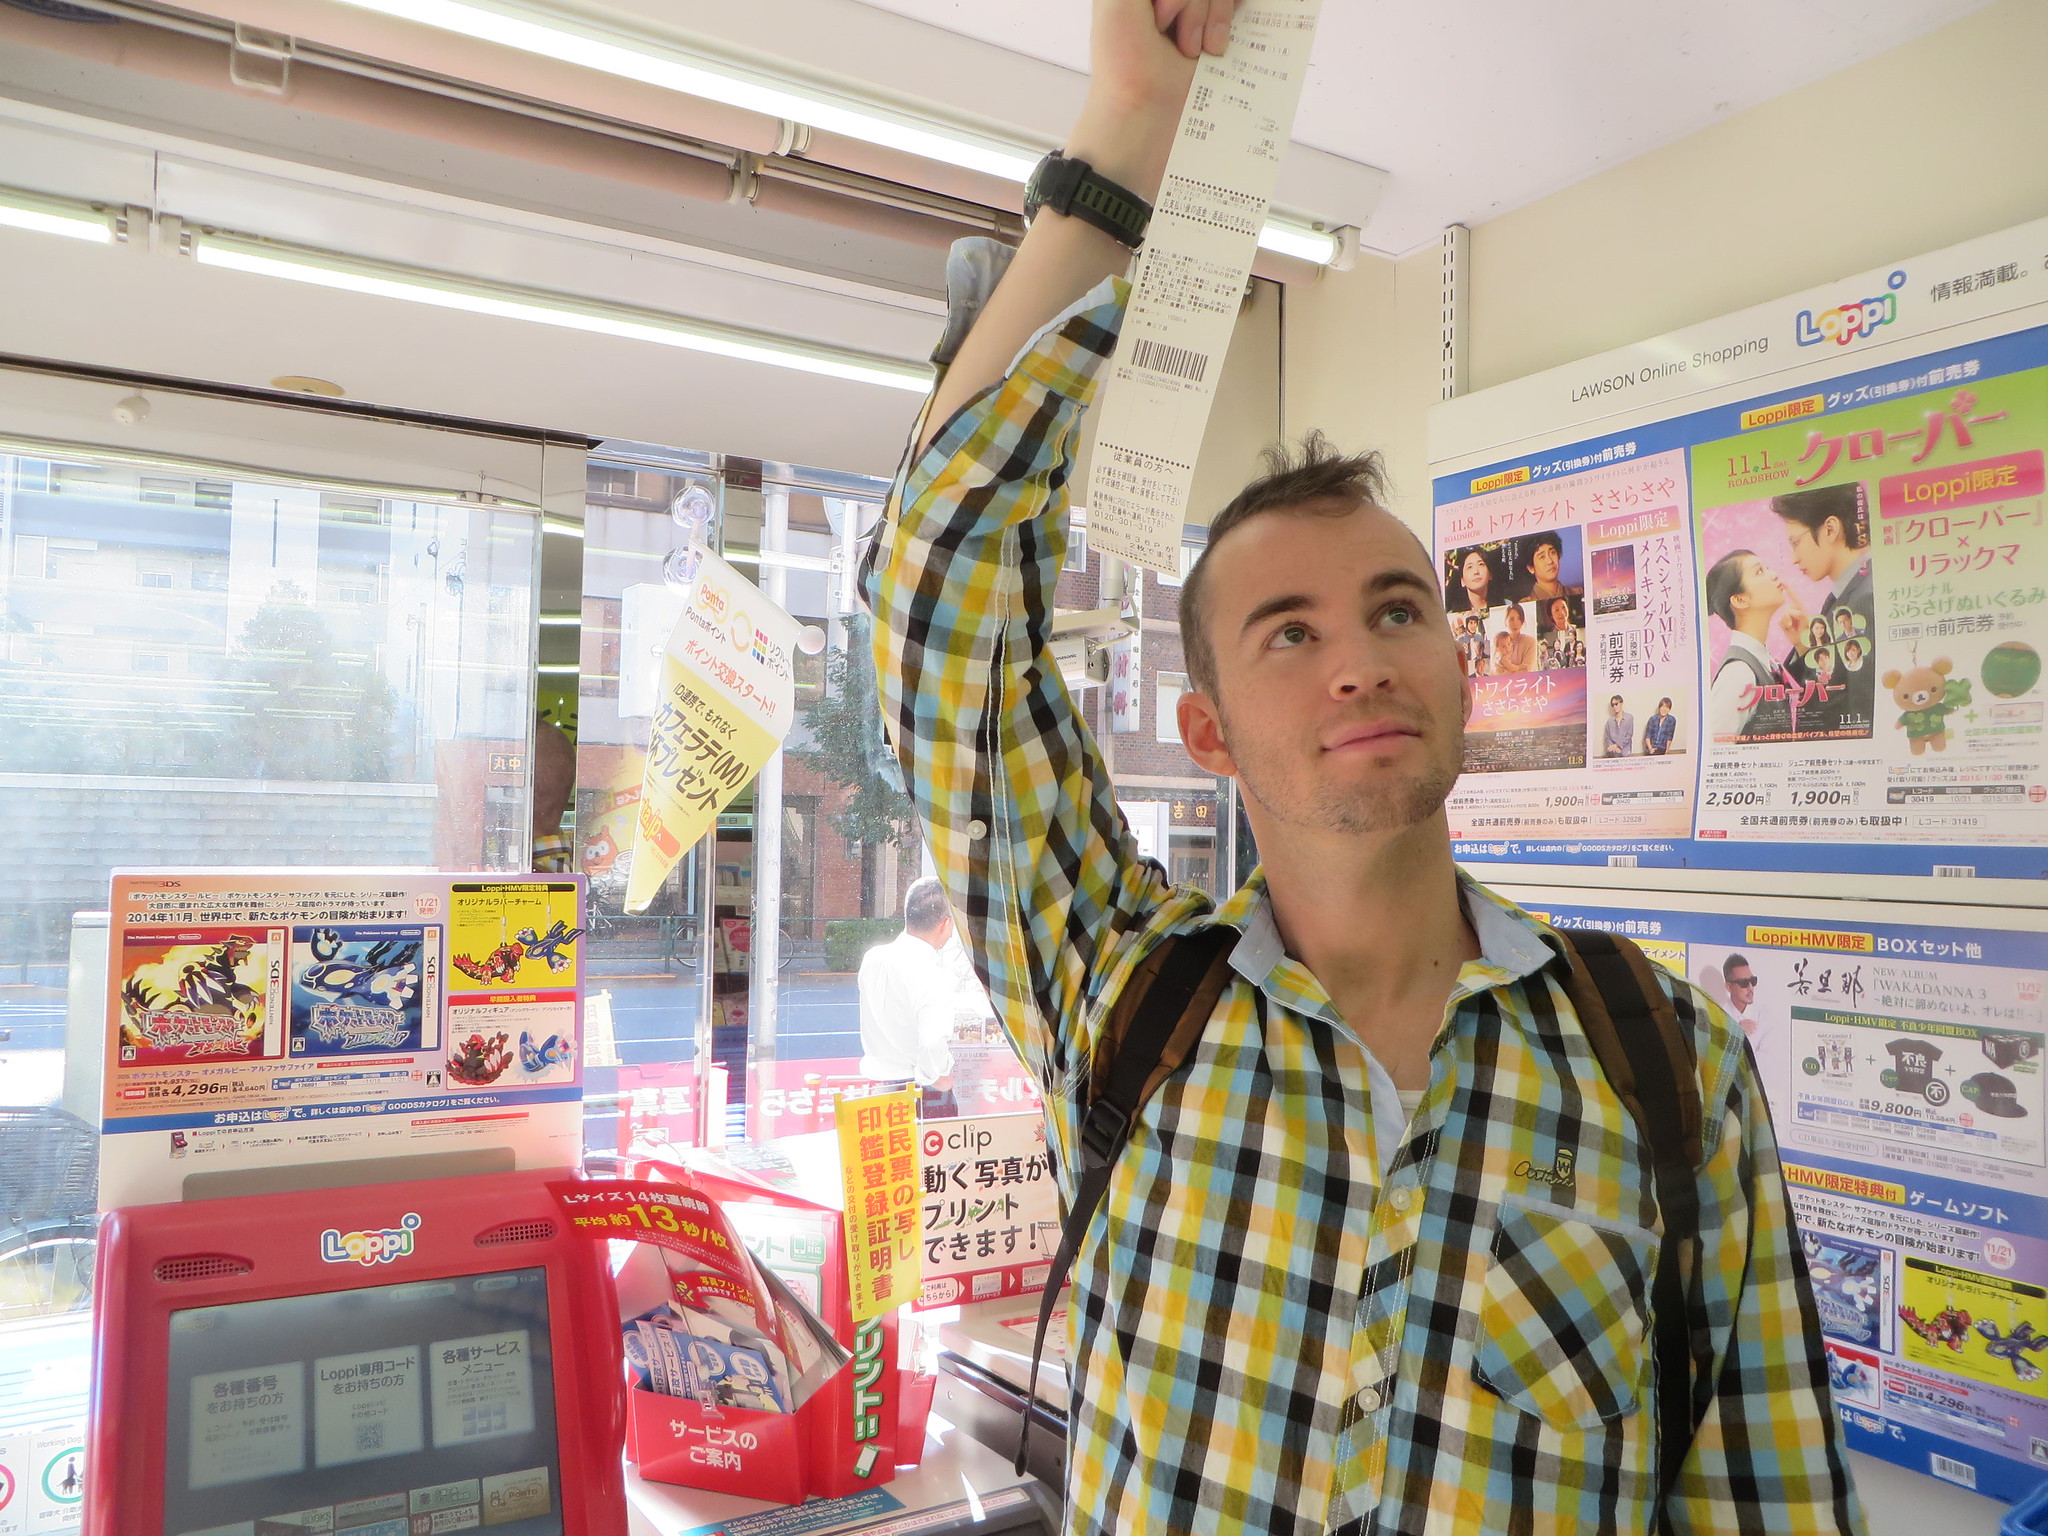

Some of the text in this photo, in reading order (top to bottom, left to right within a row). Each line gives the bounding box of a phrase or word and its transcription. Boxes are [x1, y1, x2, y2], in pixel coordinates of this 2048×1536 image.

[1571, 372, 1636, 403] LAWSON
[1639, 359, 1689, 385] Online
[1691, 335, 1770, 370] Shopping
[1796, 270, 1908, 347] Loppi
[1931, 261, 2028, 303] 情報満載。
[1748, 361, 1981, 427] Loppi限定 グッズ(引換券)付前売券
[1795, 389, 2008, 487] クローバー
[1113, 451, 1174, 475] 従業員の方へ
[1476, 470, 1524, 492] Loppi限定
[1532, 441, 1637, 478] グッズ(引換券)付前売券
[1727, 469, 1790, 488] ROADSHOW
[1903, 464, 2018, 505] Loppi限定
[1488, 498, 1576, 534] トワイライト
[1590, 477, 1676, 514] ささらさや
[1094, 512, 1153, 534] 0120-301-319
[1450, 516, 1474, 532] 11.8
[1599, 511, 1670, 540] Loppi限定
[1444, 529, 1482, 543] ROADSHOW
[1909, 543, 2021, 578] リラックマ
[700, 583, 725, 611] Ponta
[1888, 582, 1952, 600] オリジナル
[1640, 540, 1655, 678] メイキングDVD
[685, 606, 728, 644] Pontaポイント
[1926, 614, 1994, 637] 付前売券
[766, 656, 791, 681] ポイント
[1609, 632, 1624, 683] 前売券
[1629, 663, 1638, 675] 付
[1473, 674, 1556, 700] トワイライト
[1737, 671, 1846, 711] クローバー
[1482, 694, 1548, 718] ささらさや
[656, 701, 750, 791] カフェラテ(M)
[1567, 754, 1584, 765] 11.8
[1172, 800, 1208, 820] 吉田
[1544, 795, 1584, 807] 1,900円
[1706, 791, 1850, 806] 2,500円 1,900円
[159, 880, 181, 888] 3DS
[415, 898, 438, 908] 11/21
[419, 907, 437, 915] 発売!
[457, 898, 542, 907] オリジナルラバーチャーム
[1552, 915, 1662, 935] グッズ(引換券)付前売券
[1752, 928, 1983, 960] Loppi・HMV限定 BOXセット他
[270, 960, 280, 988] 3DS
[426, 956, 436, 981] 3DS
[1872, 967, 1938, 980] NEW ALBUM
[1787, 958, 1865, 1008] 若旦那
[1979, 990, 1986, 999] 3
[132, 1070, 199, 1079] ポケットモンスター
[162, 1083, 228, 1097] 各4,296円
[1870, 1100, 1922, 1118] 9,800円
[948, 1124, 992, 1155] clip
[885, 1101, 916, 1262] 住民票の写し
[924, 1152, 1049, 1195] 動く写真が
[857, 1108, 894, 1302] 印鑑登録証明書
[925, 1193, 1019, 1231] プリント
[1910, 1191, 2009, 1225] ゲームソフト
[320, 1212, 422, 1267] Loppi
[925, 1222, 1038, 1264] できます!
[1987, 1243, 2012, 1256] 11/21
[926, 1282, 947, 1291] ご利用は
[442, 1341, 521, 1365] 各種サービス
[320, 1356, 416, 1381] Loppi専用コード
[461, 1361, 505, 1376] メニュー
[213, 1374, 278, 1399] 各種番号
[333, 1375, 405, 1396] をお持ちの方
[206, 1392, 285, 1414] をお持ちの方
[36, 1435, 81, 1449] Working Dog
[670, 1419, 758, 1451] サービスの
[689, 1446, 743, 1473] ご案内
